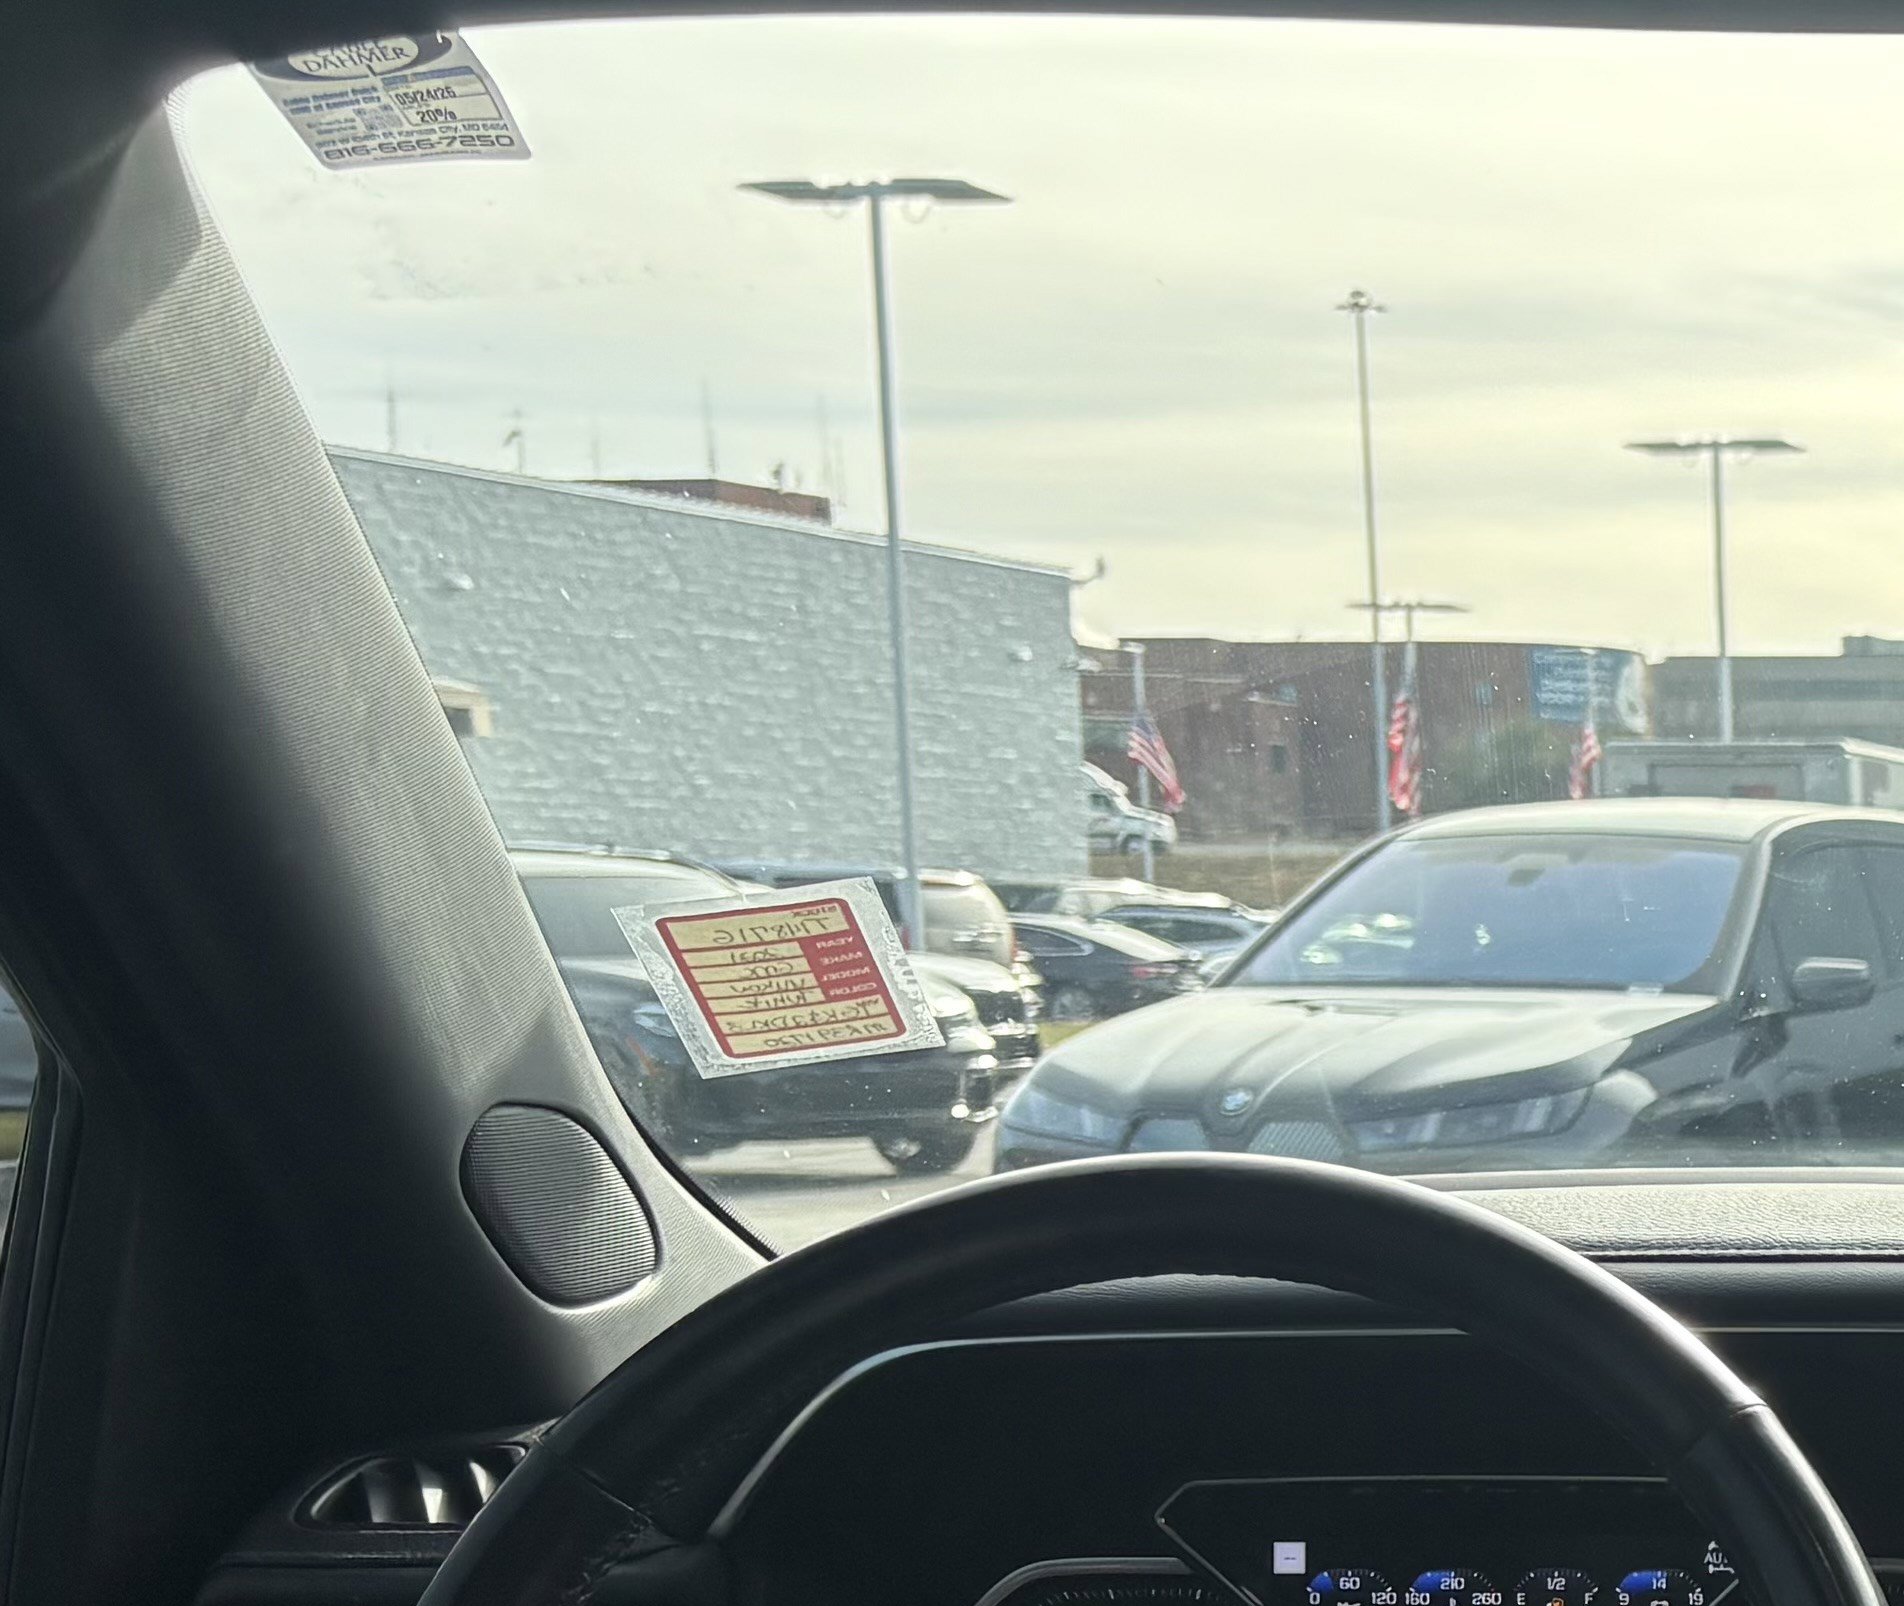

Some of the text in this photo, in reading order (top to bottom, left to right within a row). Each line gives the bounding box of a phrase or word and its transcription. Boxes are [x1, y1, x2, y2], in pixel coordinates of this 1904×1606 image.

[302, 46, 411, 72] DAHMER
[415, 106, 457, 123] 20%
[324, 134, 515, 160] 816-666-7250
[1703, 1552, 1728, 1565] AU
[1339, 1576, 1361, 1590] 60
[1440, 1576, 1465, 1590] 210
[1546, 1576, 1566, 1591] 1/2
[1651, 1577, 1666, 1590] 14
[1308, 1592, 1321, 1606] 0
[1370, 1591, 1397, 1606] 120
[1404, 1591, 1430, 1606] 160
[1471, 1591, 1502, 1606] 260
[1516, 1592, 1527, 1606] E
[1584, 1592, 1594, 1606] F
[1619, 1592, 1630, 1606] 9
[1687, 1591, 1704, 1606] 19
